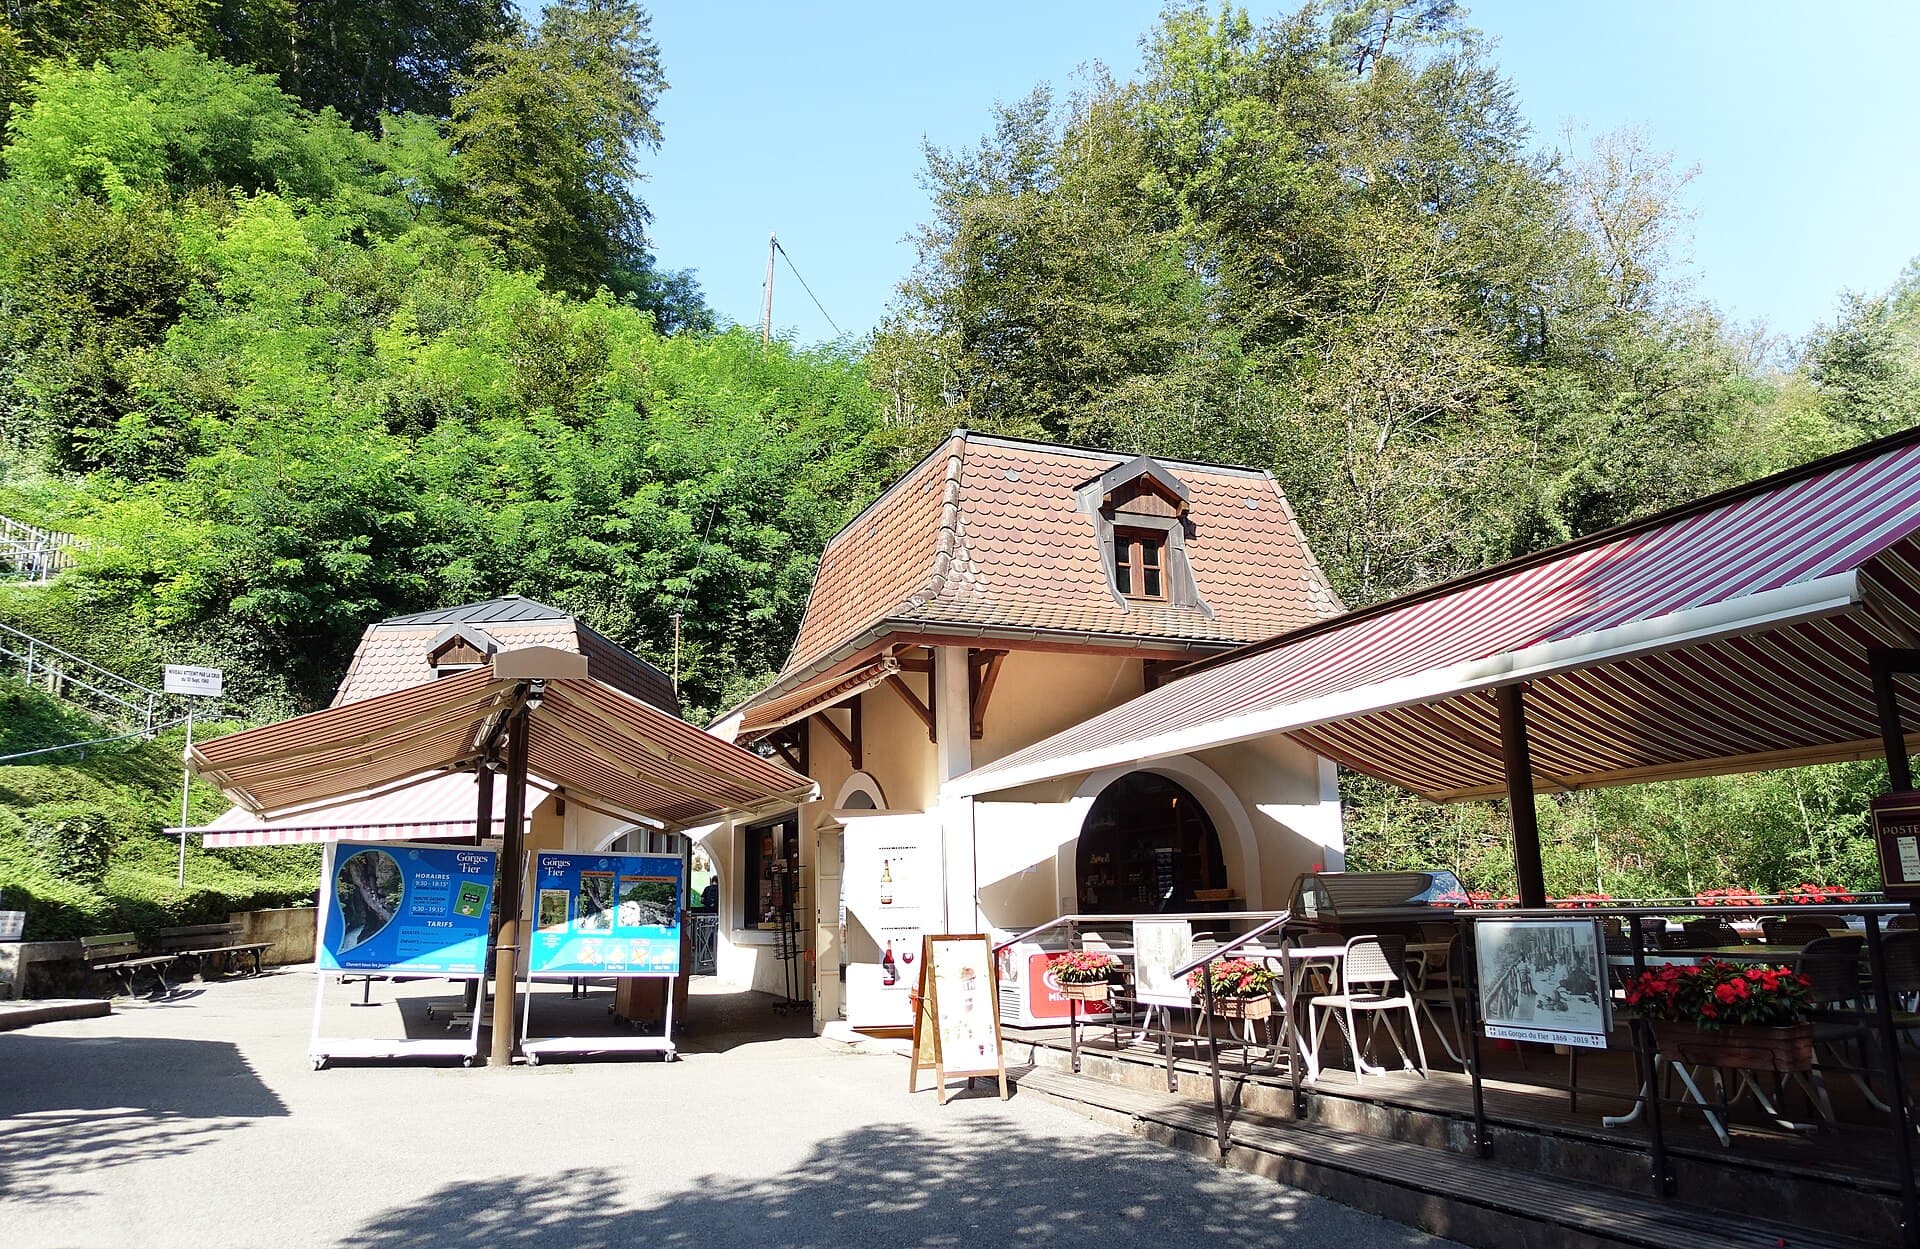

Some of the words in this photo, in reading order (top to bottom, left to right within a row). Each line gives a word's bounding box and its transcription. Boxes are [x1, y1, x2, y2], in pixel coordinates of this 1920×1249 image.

[456, 852, 489, 864] Gorges
[542, 857, 571, 869] Gorges
[462, 863, 481, 873] Fier
[548, 867, 565, 877] Fier
[427, 920, 454, 928] TARIFS
[1498, 1029, 1507, 1037] Les
[1508, 1030, 1528, 1039] Gorges
[1538, 1032, 1549, 1040] Fier
[1573, 1035, 1589, 1044] 2019
